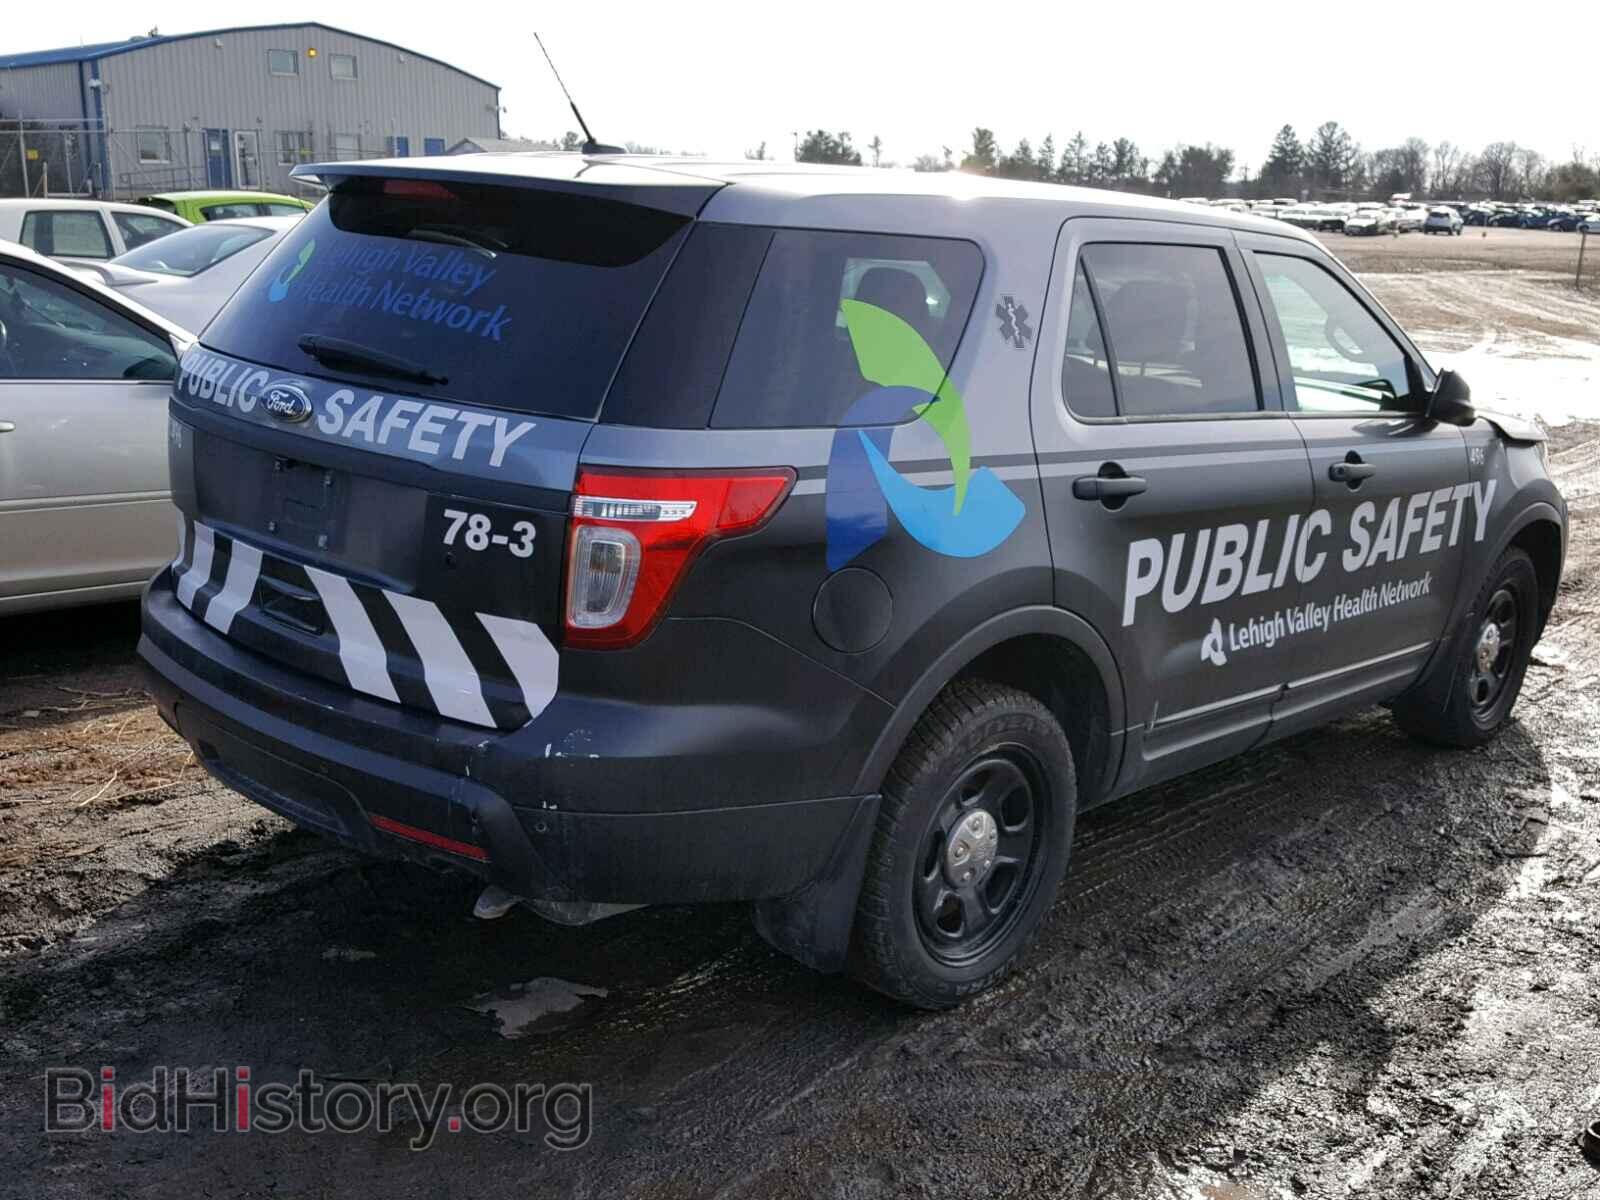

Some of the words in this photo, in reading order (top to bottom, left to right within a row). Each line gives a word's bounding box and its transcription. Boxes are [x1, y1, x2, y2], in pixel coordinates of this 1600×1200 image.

[319, 240, 401, 272] Lehigh
[405, 245, 496, 296] Valley
[299, 272, 372, 308] Health
[370, 280, 512, 341] Network
[178, 353, 269, 412] PUBLIC
[318, 389, 536, 467] SAFETY
[443, 509, 536, 558] 78-3
[1122, 509, 1332, 627] PUBLIC
[1342, 479, 1497, 572] SAFETY
[1228, 612, 1286, 652] Lehigh
[1286, 602, 1332, 632] Valley
[1333, 586, 1377, 624] Health
[1378, 571, 1432, 609] Network
